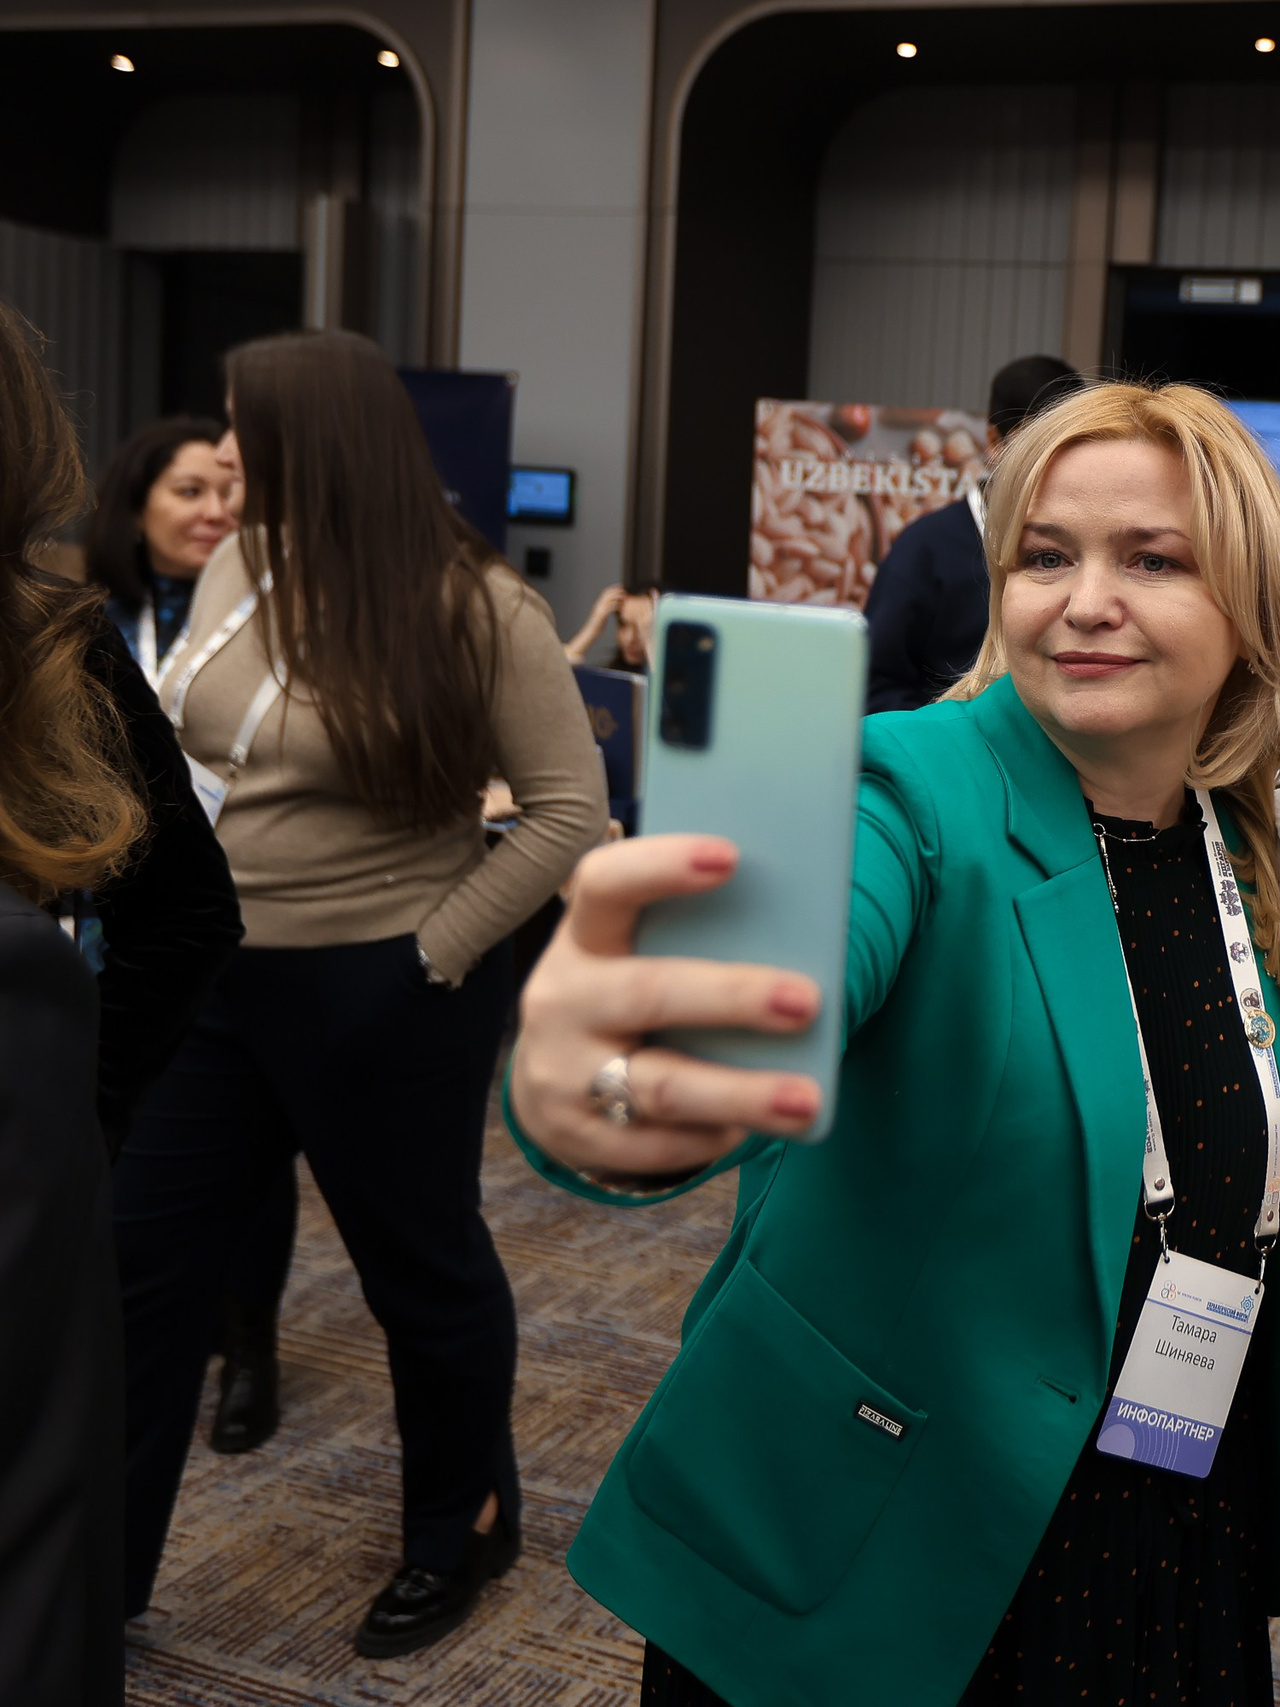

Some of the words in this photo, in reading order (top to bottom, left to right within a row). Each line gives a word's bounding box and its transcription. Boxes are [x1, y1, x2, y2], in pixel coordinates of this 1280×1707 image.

[779, 460, 984, 498] UZBEKISTA
[1170, 1314, 1218, 1345] Тамара
[1155, 1338, 1216, 1371] Шиняева
[1117, 1402, 1215, 1442] ИНФОПАРТНЕР
